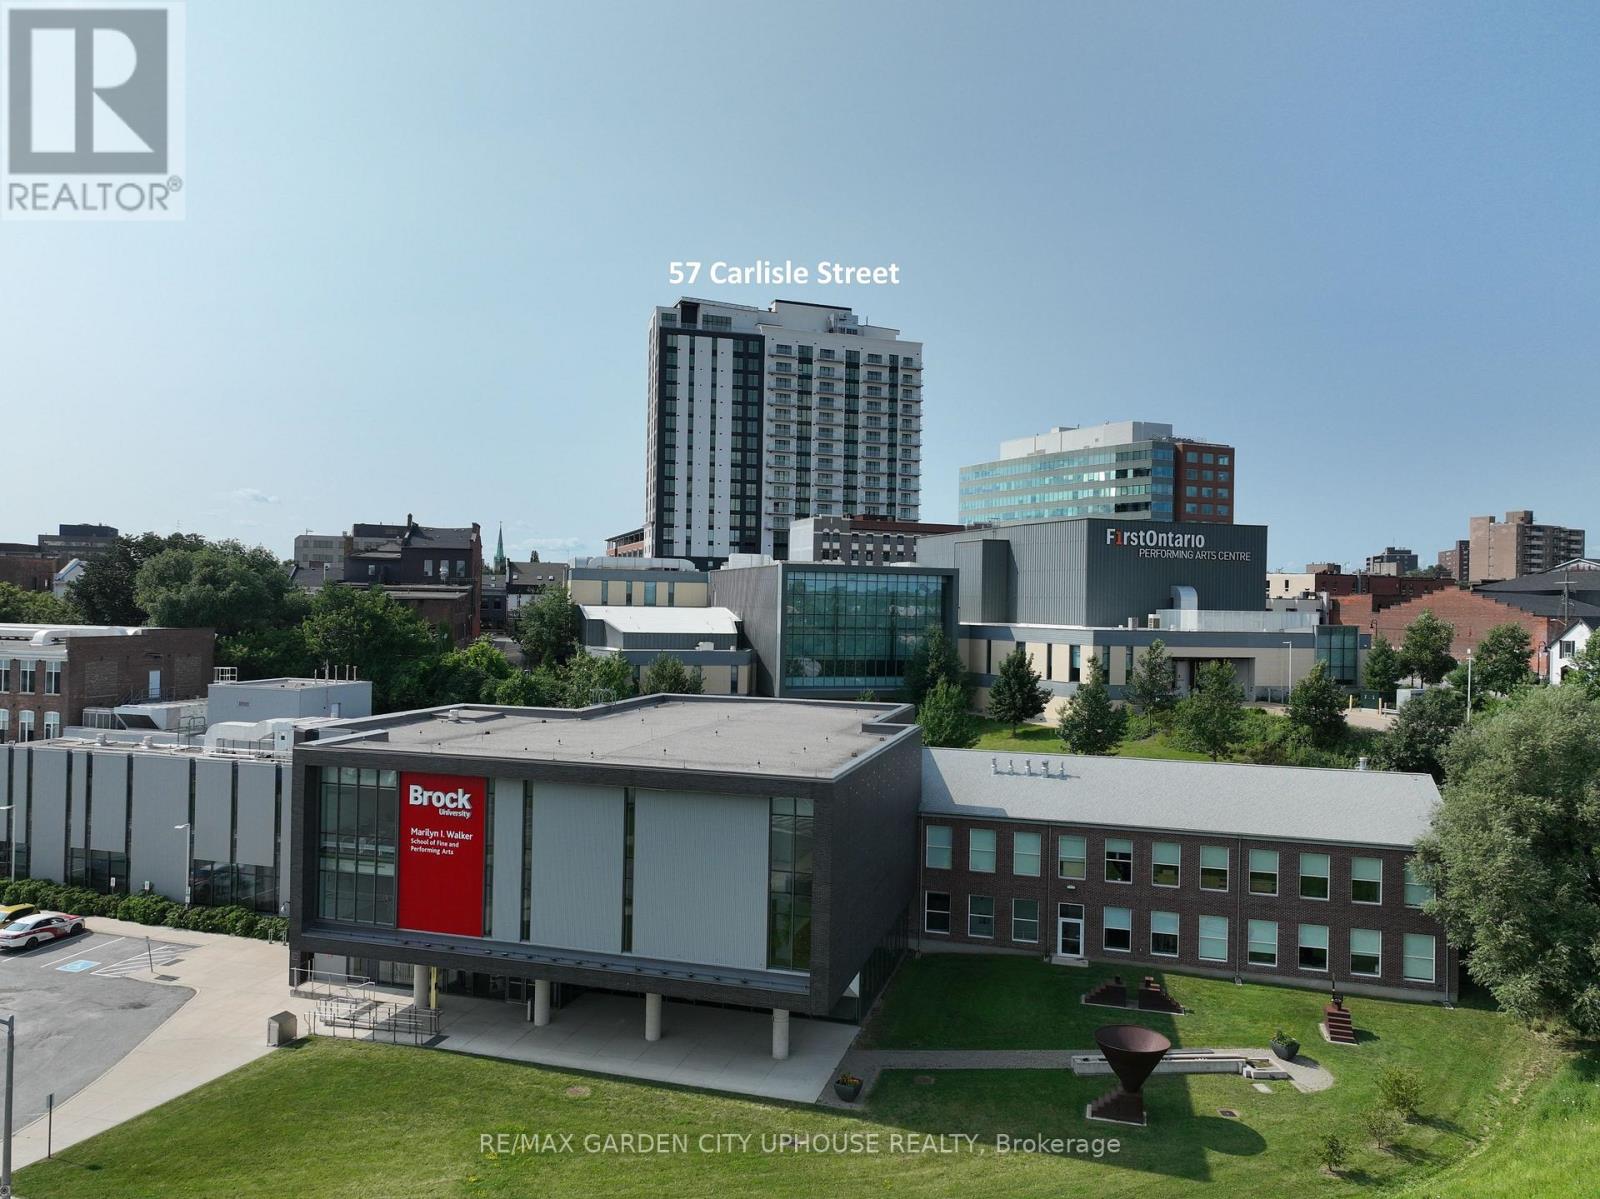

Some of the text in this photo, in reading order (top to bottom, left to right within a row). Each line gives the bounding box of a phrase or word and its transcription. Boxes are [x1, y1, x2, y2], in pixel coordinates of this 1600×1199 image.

[1106, 528, 1205, 548] FirstOntario
[1139, 548, 1251, 562] PERFORMING ARTS CENTRE
[409, 784, 471, 809] Brock
[438, 808, 471, 819] University
[410, 827, 439, 838] Marilyn
[446, 830, 473, 840] Walker
[410, 846, 441, 855] Performing
